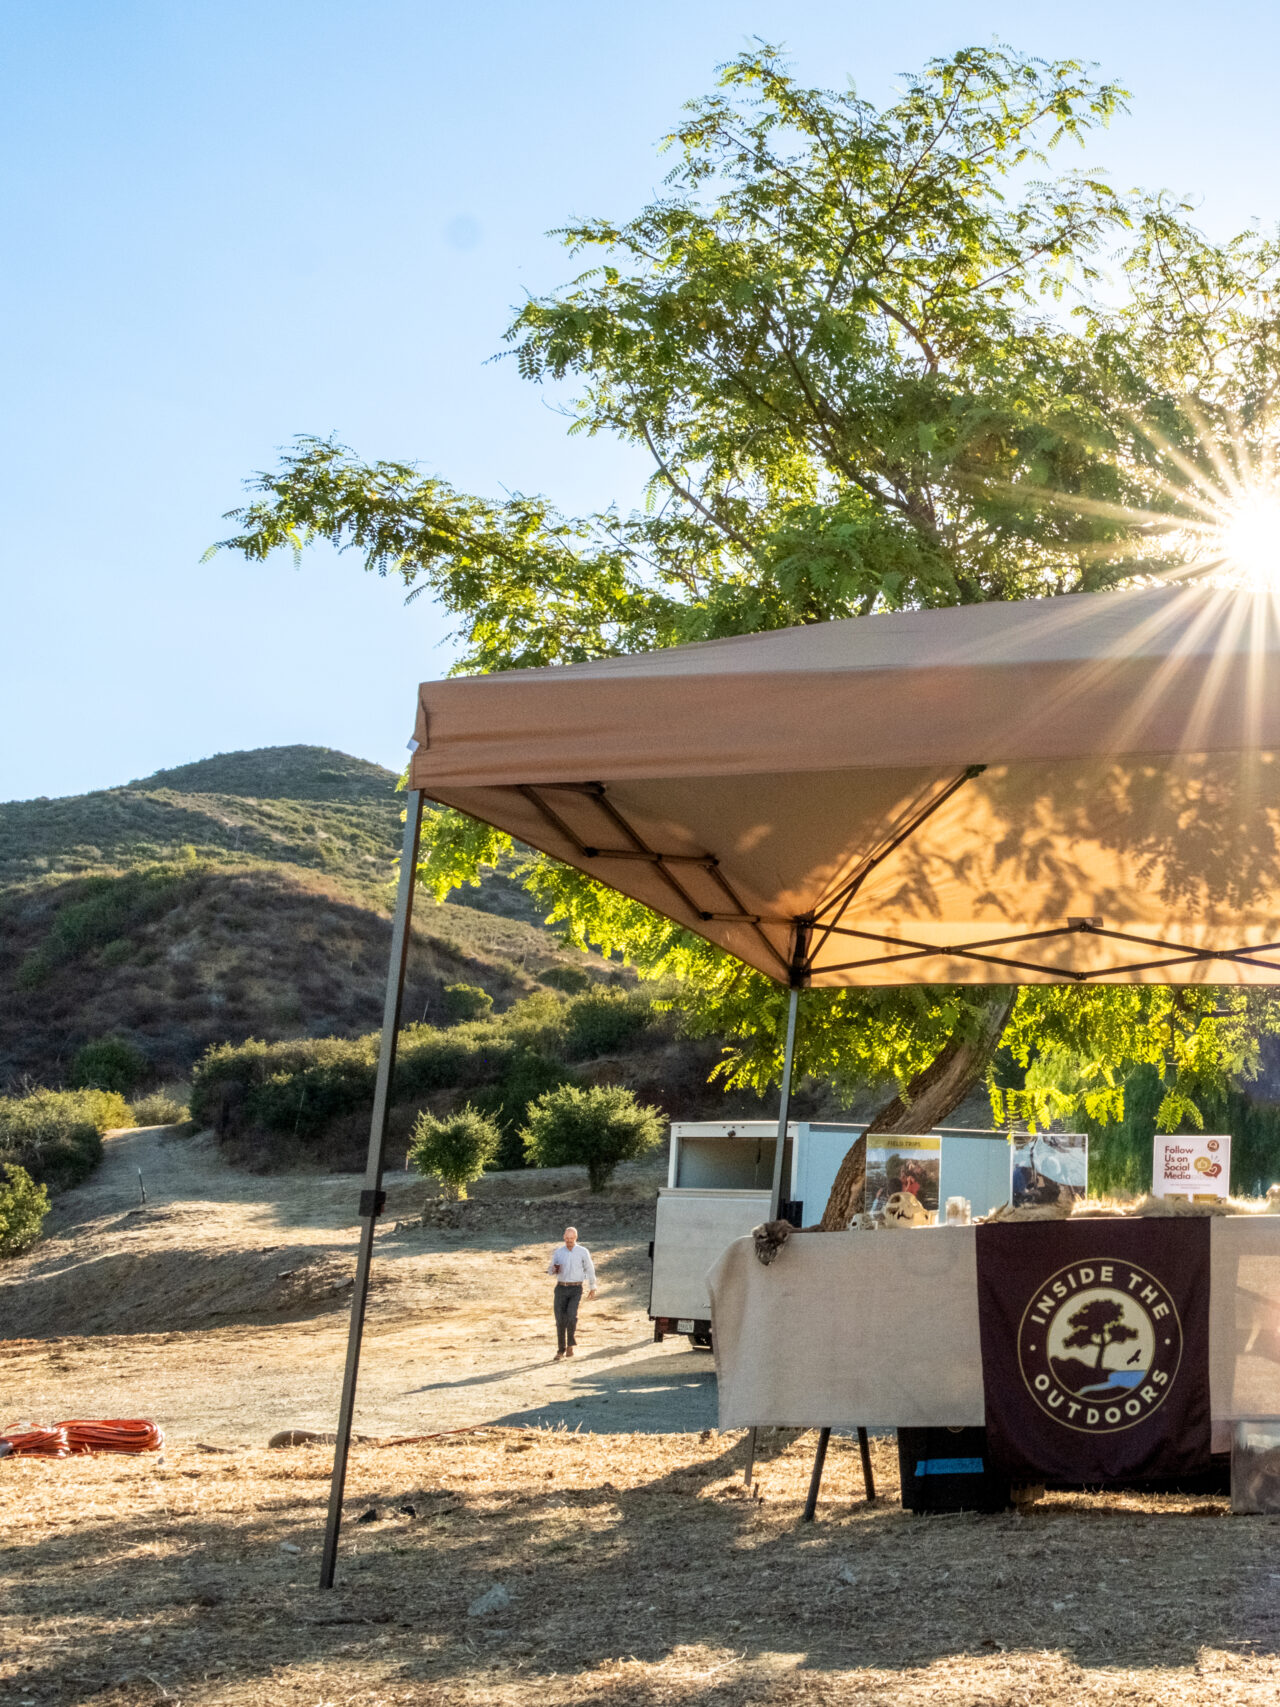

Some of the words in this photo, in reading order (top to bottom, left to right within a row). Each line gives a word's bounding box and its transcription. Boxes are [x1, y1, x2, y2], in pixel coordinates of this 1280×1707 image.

[1164, 1145, 1194, 1154] Follow
[1164, 1154, 1175, 1162] Us
[1164, 1163, 1190, 1171] Social
[1163, 1171, 1191, 1180] Media
[1030, 1266, 1114, 1325] INSIDE
[1126, 1272, 1171, 1320] THE
[1034, 1369, 1169, 1425] OUTDOORS
